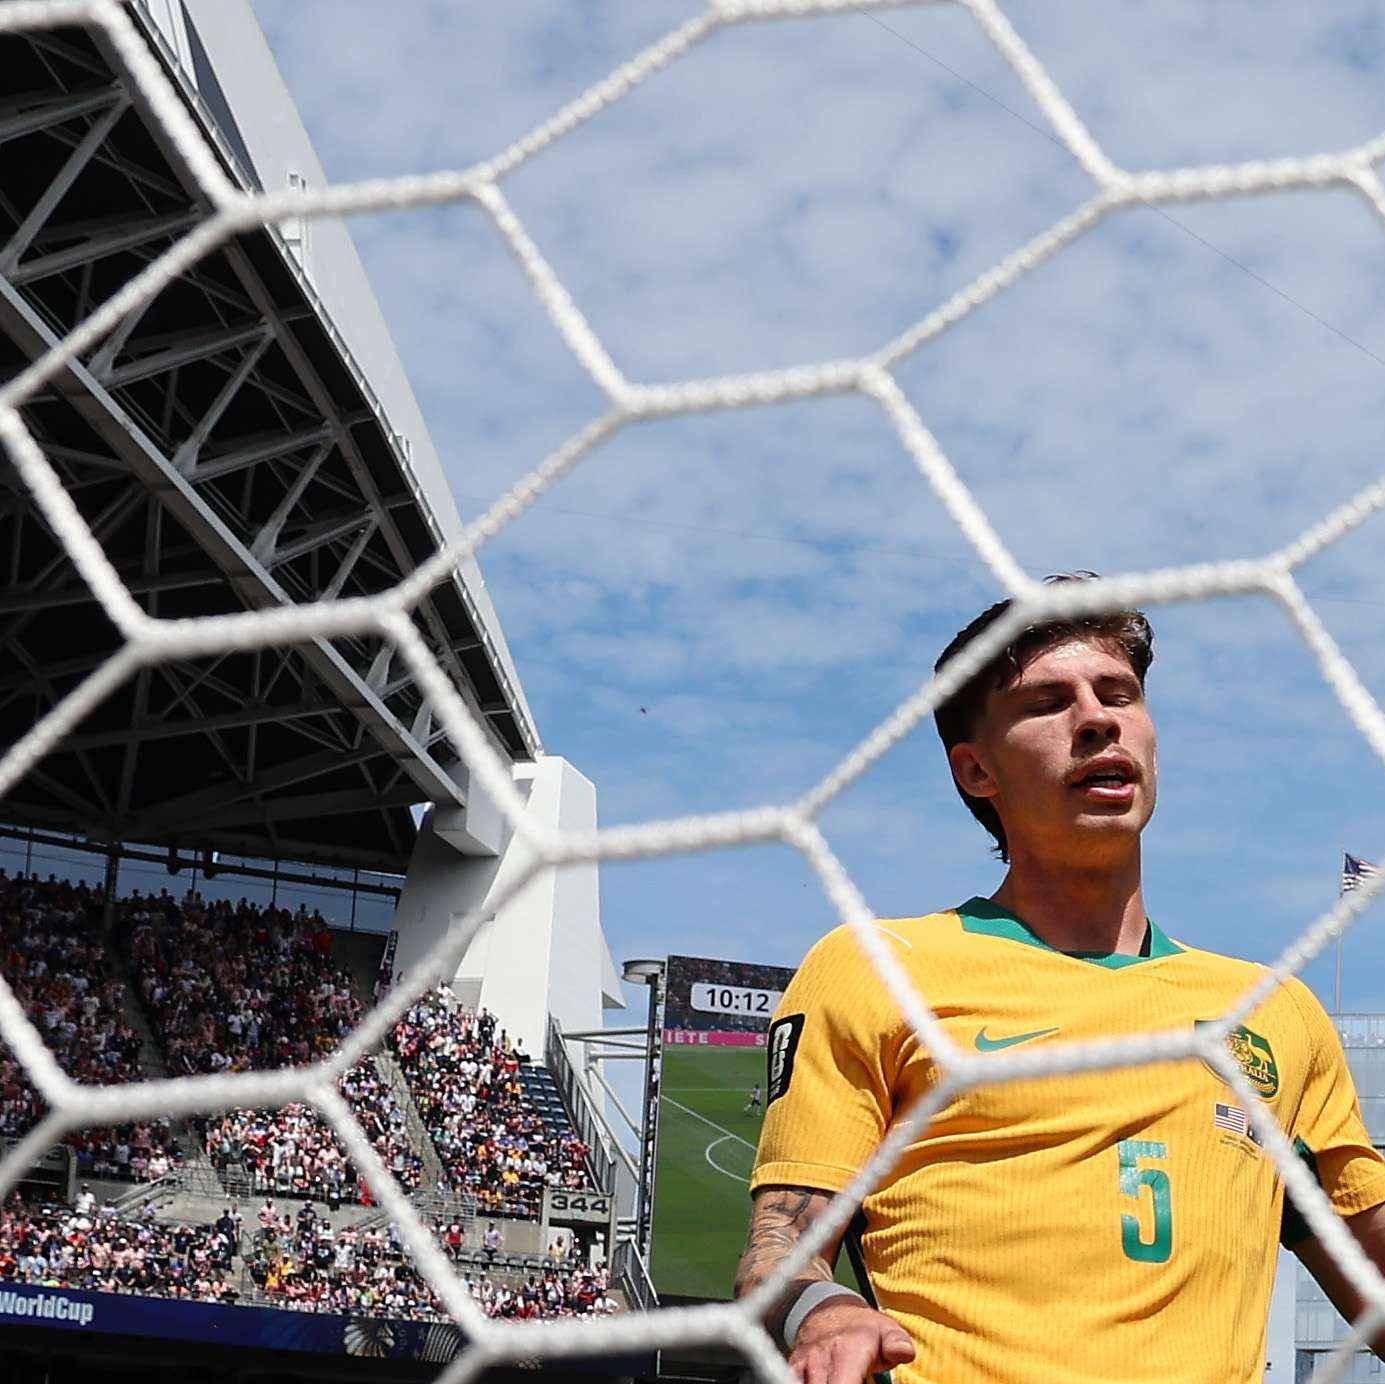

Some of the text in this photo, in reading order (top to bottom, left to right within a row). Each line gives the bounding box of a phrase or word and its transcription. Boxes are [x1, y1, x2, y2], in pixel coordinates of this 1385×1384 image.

[706, 988, 770, 1012] 10:12
[666, 1031, 709, 1044] IETE
[551, 1195, 609, 1214] 344
[1117, 1140, 1173, 1263] 5
